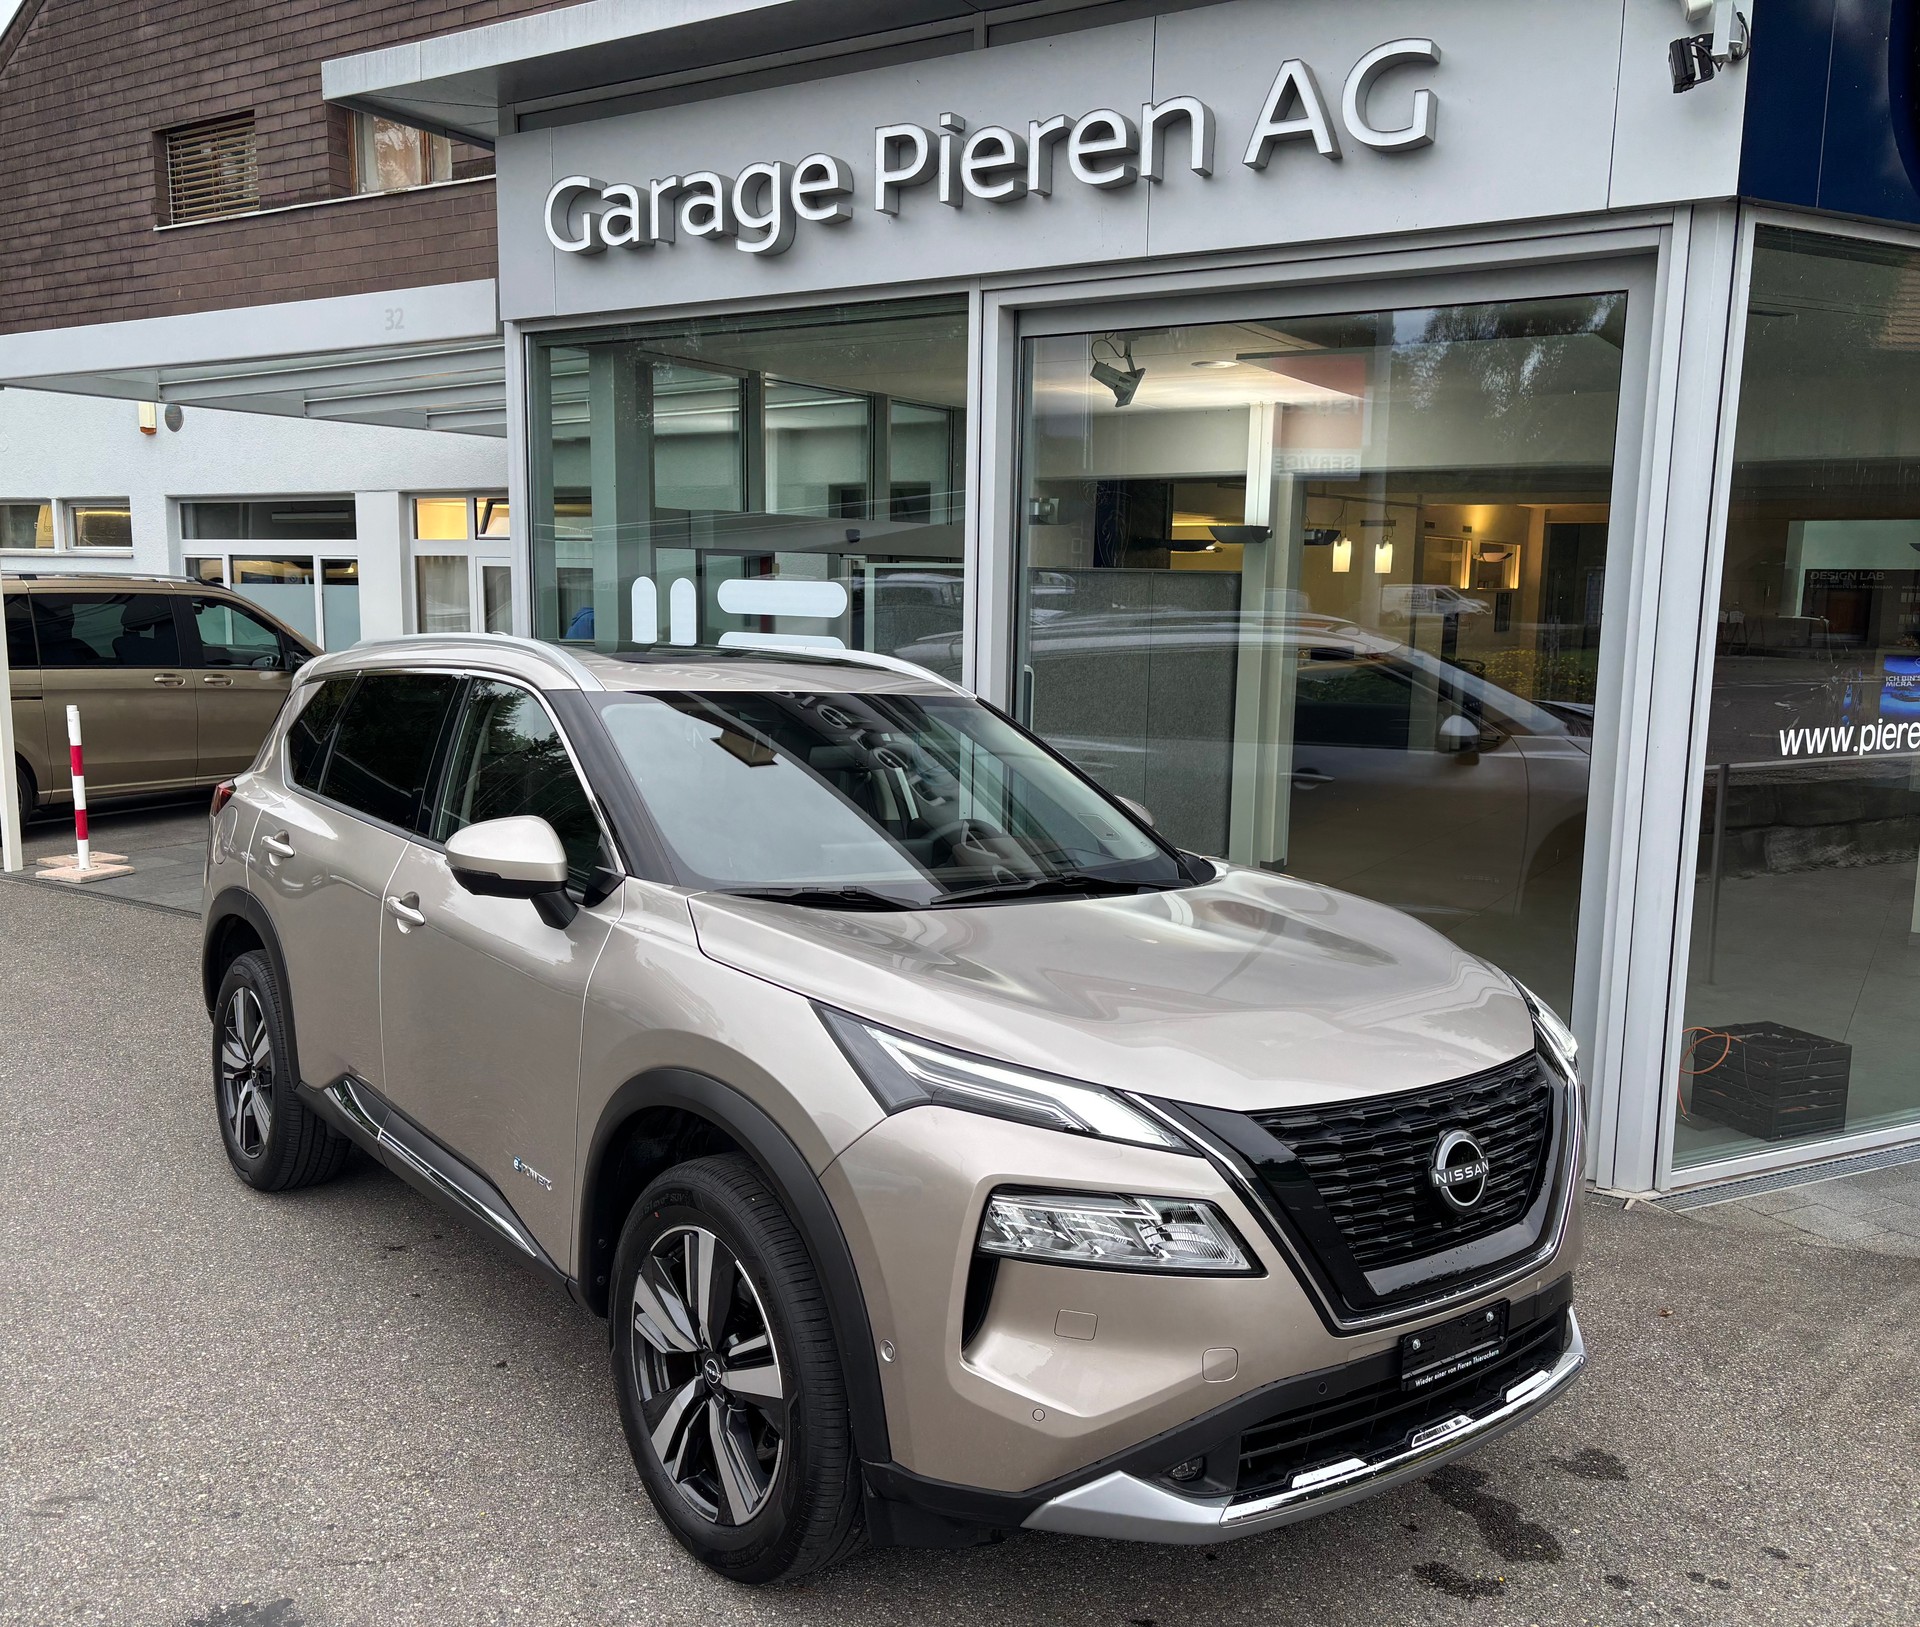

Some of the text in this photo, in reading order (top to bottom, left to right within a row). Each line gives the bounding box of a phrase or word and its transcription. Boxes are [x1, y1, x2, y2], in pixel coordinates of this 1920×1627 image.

[544, 37, 1441, 256] Garage Pieren AG
[384, 308, 404, 330] 32
[1810, 571, 1885, 580] DESIGN LAB
[1779, 718, 1920, 756] www.piere
[1434, 1161, 1489, 1185] NISSAN
[1415, 1374, 1434, 1387] Wieder
[1434, 1370, 1447, 1380] einer
[1447, 1366, 1457, 1374] von
[1457, 1359, 1472, 1371] Pieren
